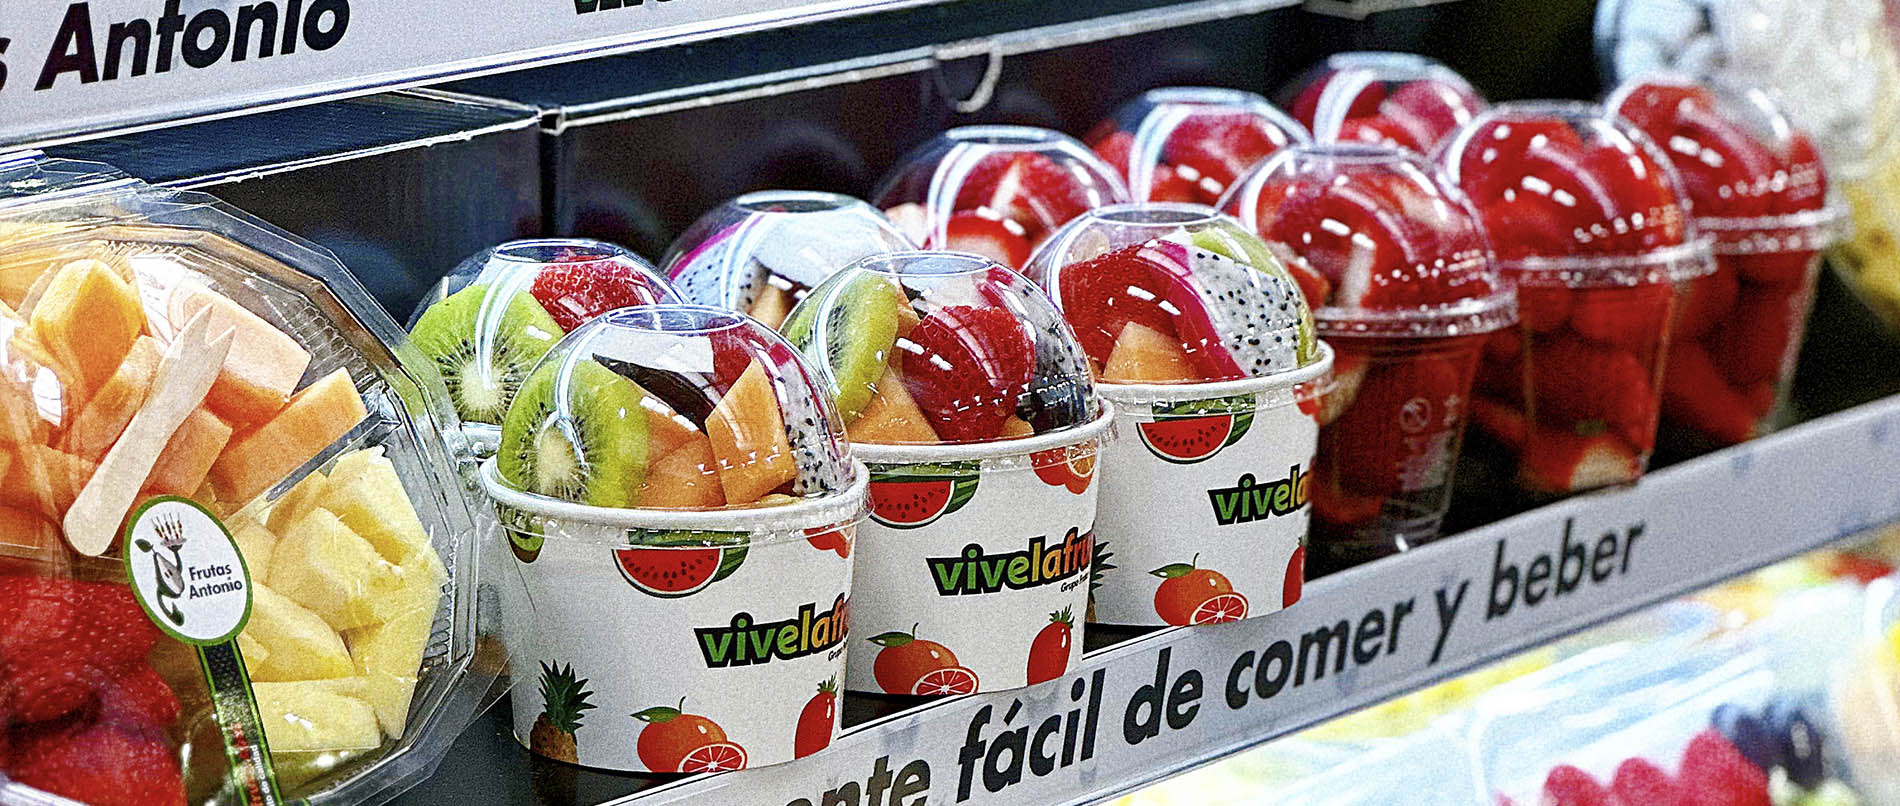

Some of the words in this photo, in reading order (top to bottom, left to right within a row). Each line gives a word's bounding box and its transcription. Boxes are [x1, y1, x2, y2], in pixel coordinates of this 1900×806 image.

[34, 0, 349, 91] Antonio
[188, 563, 232, 582] Frutas
[188, 577, 243, 600] Antonio
[956, 668, 1106, 804] fácil
[1124, 647, 1203, 745] de
[1225, 597, 1416, 711] comer
[1427, 578, 1470, 666] y
[1486, 518, 1647, 622] beber
